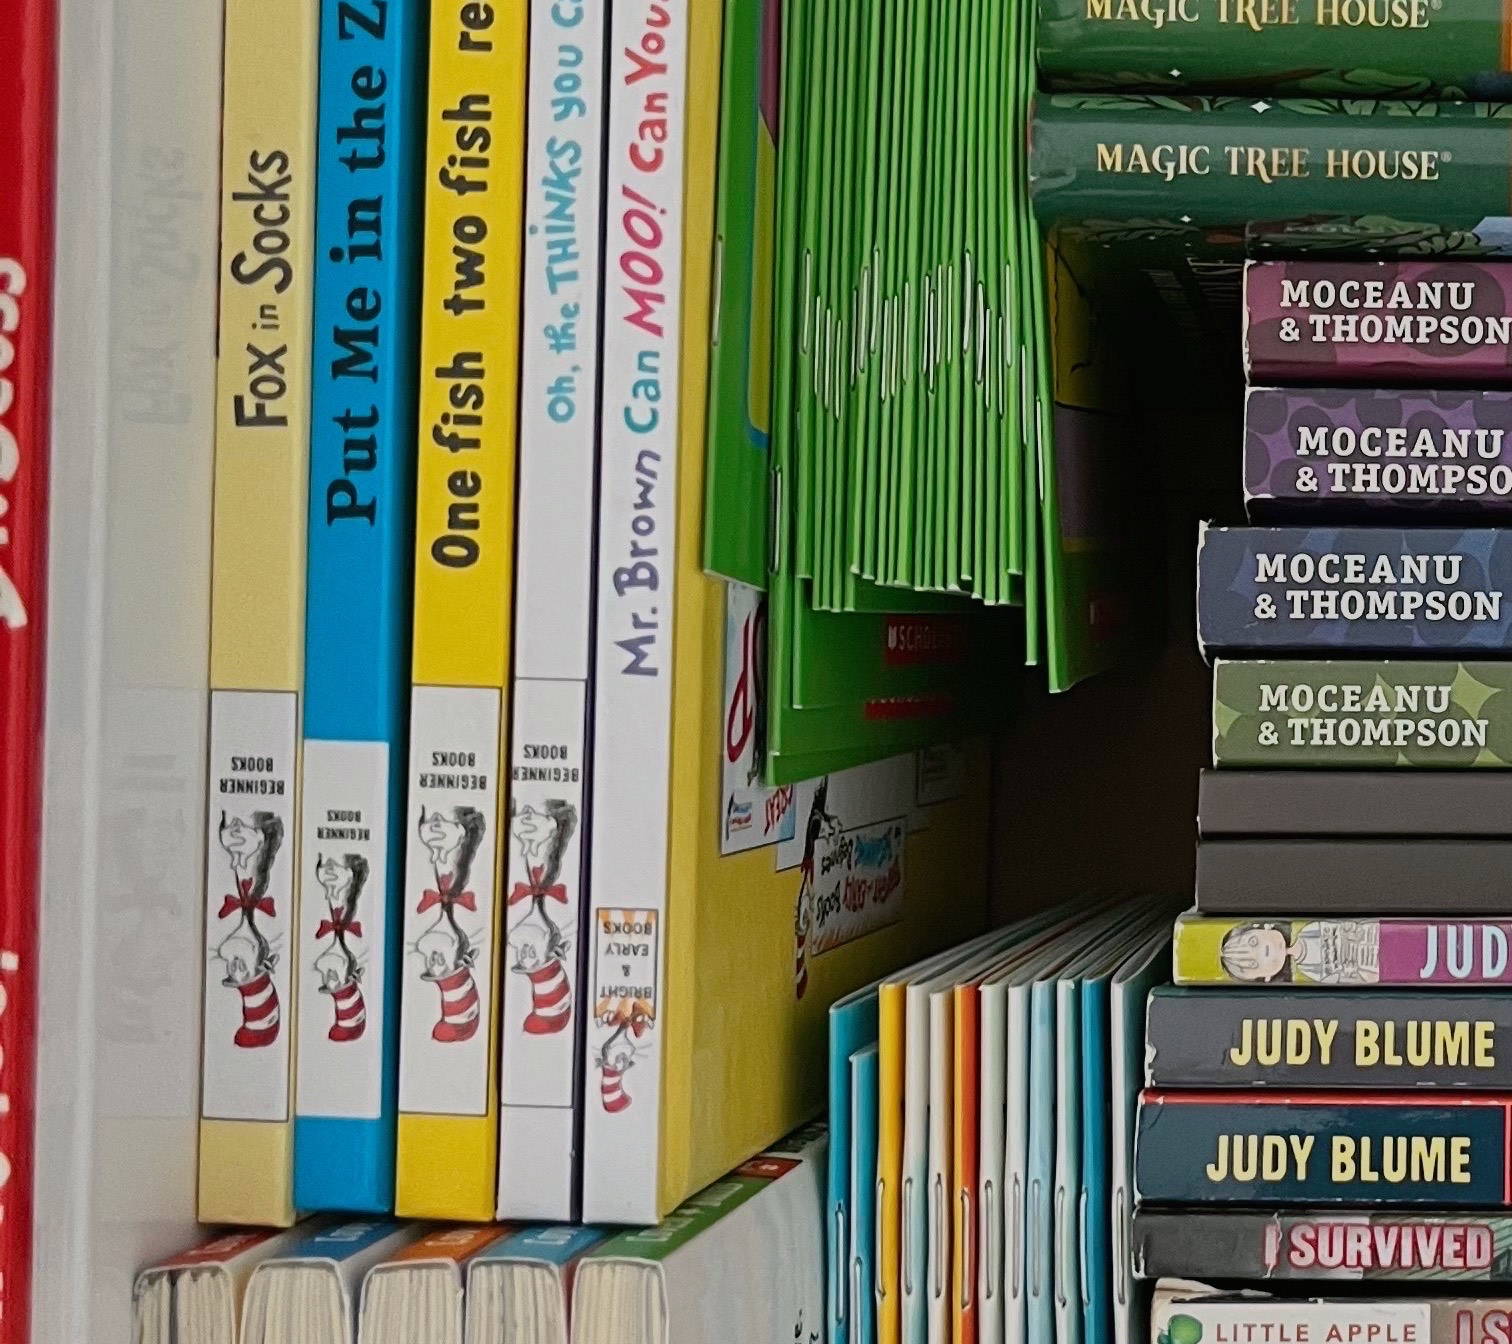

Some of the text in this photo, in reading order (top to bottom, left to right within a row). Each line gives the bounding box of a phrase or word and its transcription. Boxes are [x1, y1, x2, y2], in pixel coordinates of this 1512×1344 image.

[346, 64, 387, 175] the
[630, 92, 667, 173] Can
[330, 197, 384, 263] in
[622, 187, 665, 336] MOO!
[233, 151, 291, 428] Fox in Socks
[1281, 280, 1475, 309] MOCEANU
[333, 287, 383, 377] Me
[1279, 314, 1511, 346] & THOMPSON
[624, 349, 661, 435] Can
[328, 405, 380, 525] Put
[615, 449, 661, 597] Brown
[623, 603, 660, 677] Mr.
[219, 779, 284, 794] BEGINNER
[231, 757, 273, 771] BOOKS
[1231, 1020, 1496, 1068] JUDY BLUME
[1206, 1135, 1472, 1184] JUDY BLUME
